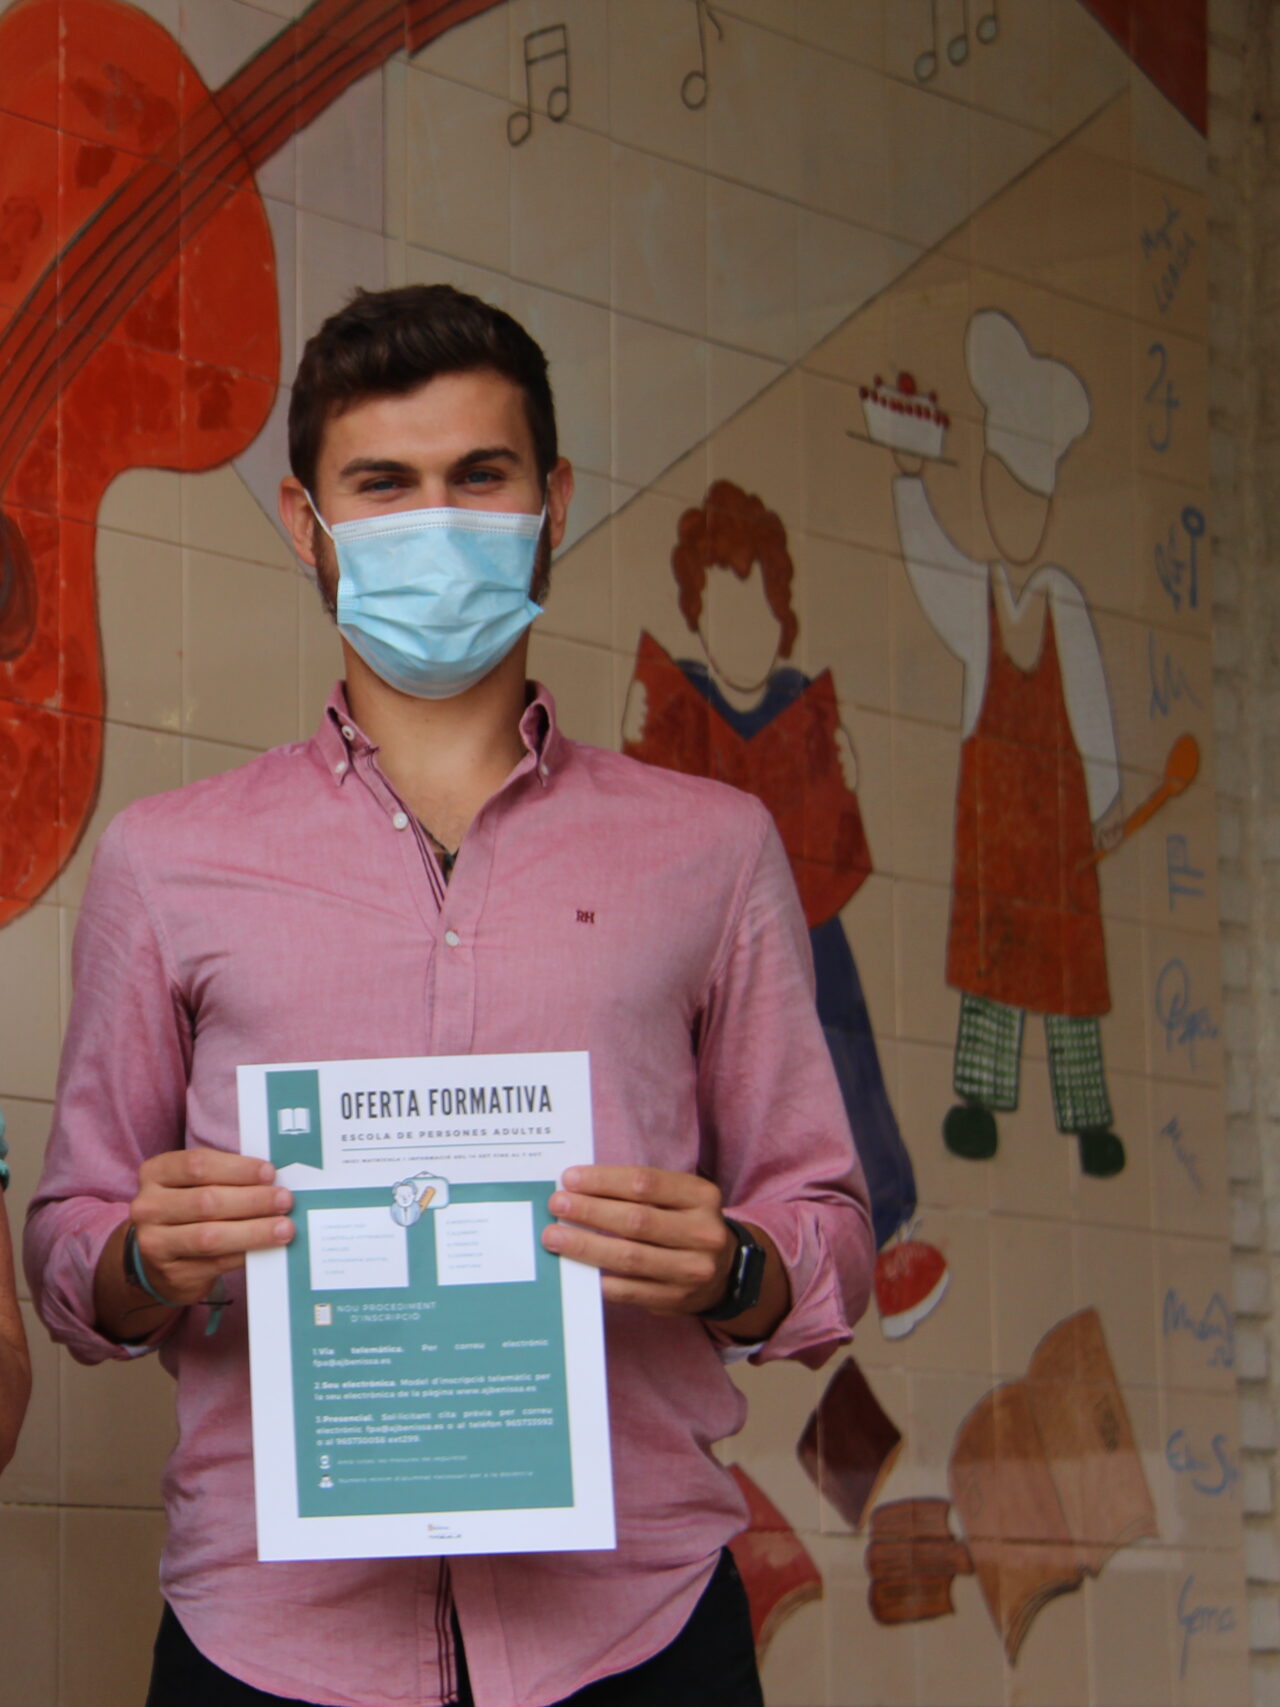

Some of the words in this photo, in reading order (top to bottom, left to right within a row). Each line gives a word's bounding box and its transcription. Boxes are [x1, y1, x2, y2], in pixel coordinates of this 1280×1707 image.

[576, 909, 595, 924] RH
[341, 1089, 420, 1120] OFERTA
[428, 1084, 553, 1116] FORMATIVA
[341, 1131, 391, 1142] ESCOLA
[396, 1131, 413, 1140] DE
[419, 1128, 488, 1139] PERSONES
[493, 1126, 552, 1137] ADULTES
[336, 1304, 360, 1313] NOU
[362, 1301, 437, 1312] PROCEDIMENT
[421, 1343, 438, 1351] Per
[454, 1342, 485, 1350] correu
[534, 1373, 551, 1382] per
[499, 1409, 515, 1418] per
[522, 1408, 553, 1416] correu
